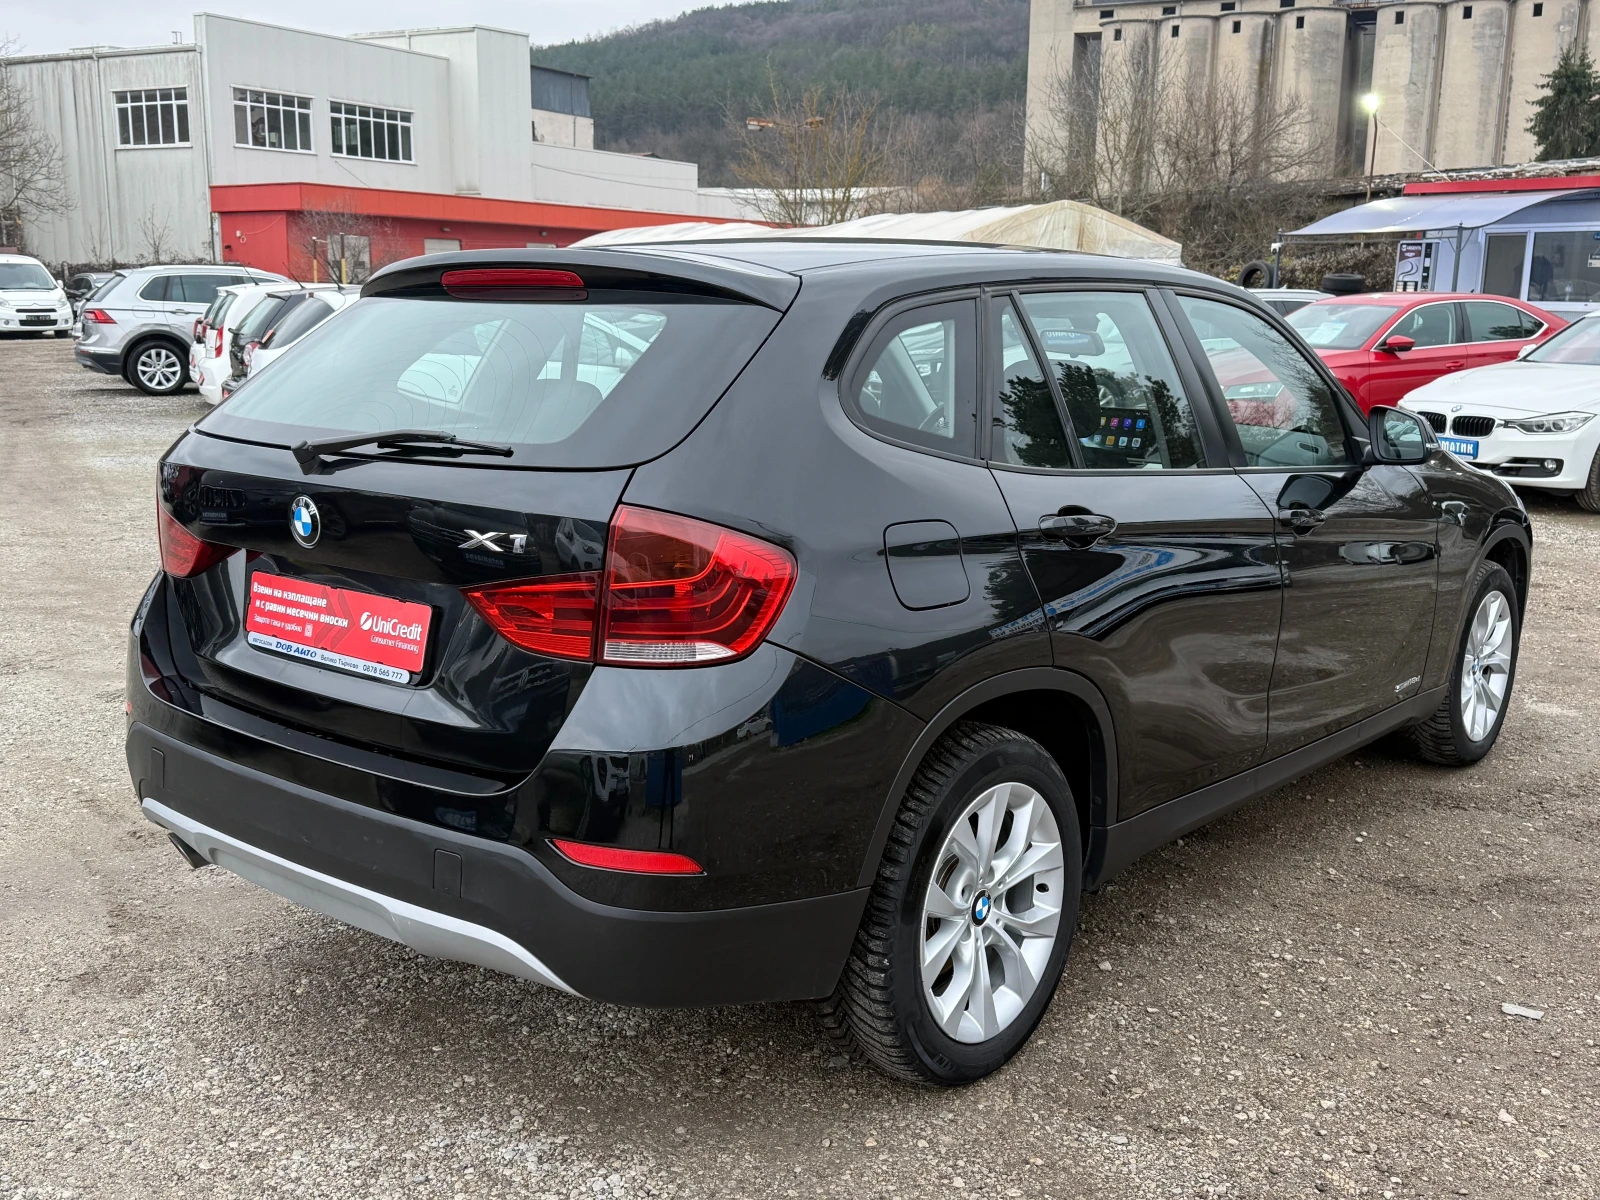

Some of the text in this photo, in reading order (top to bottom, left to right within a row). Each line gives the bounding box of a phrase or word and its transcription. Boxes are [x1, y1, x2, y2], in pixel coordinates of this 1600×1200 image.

[1438, 440, 1474, 454] МАТИК
[457, 529, 527, 553] X1
[253, 582, 327, 607] Вземи на изплащане
[255, 599, 348, 628] и с равни месечни вноски
[285, 623, 303, 633] удобно
[372, 615, 422, 641] UniCredit
[370, 634, 419, 655] Consumer Financing
[275, 641, 293, 653] DOB
[294, 646, 317, 658] AUTO
[362, 664, 378, 674] 0878
[391, 671, 403, 680] 777
